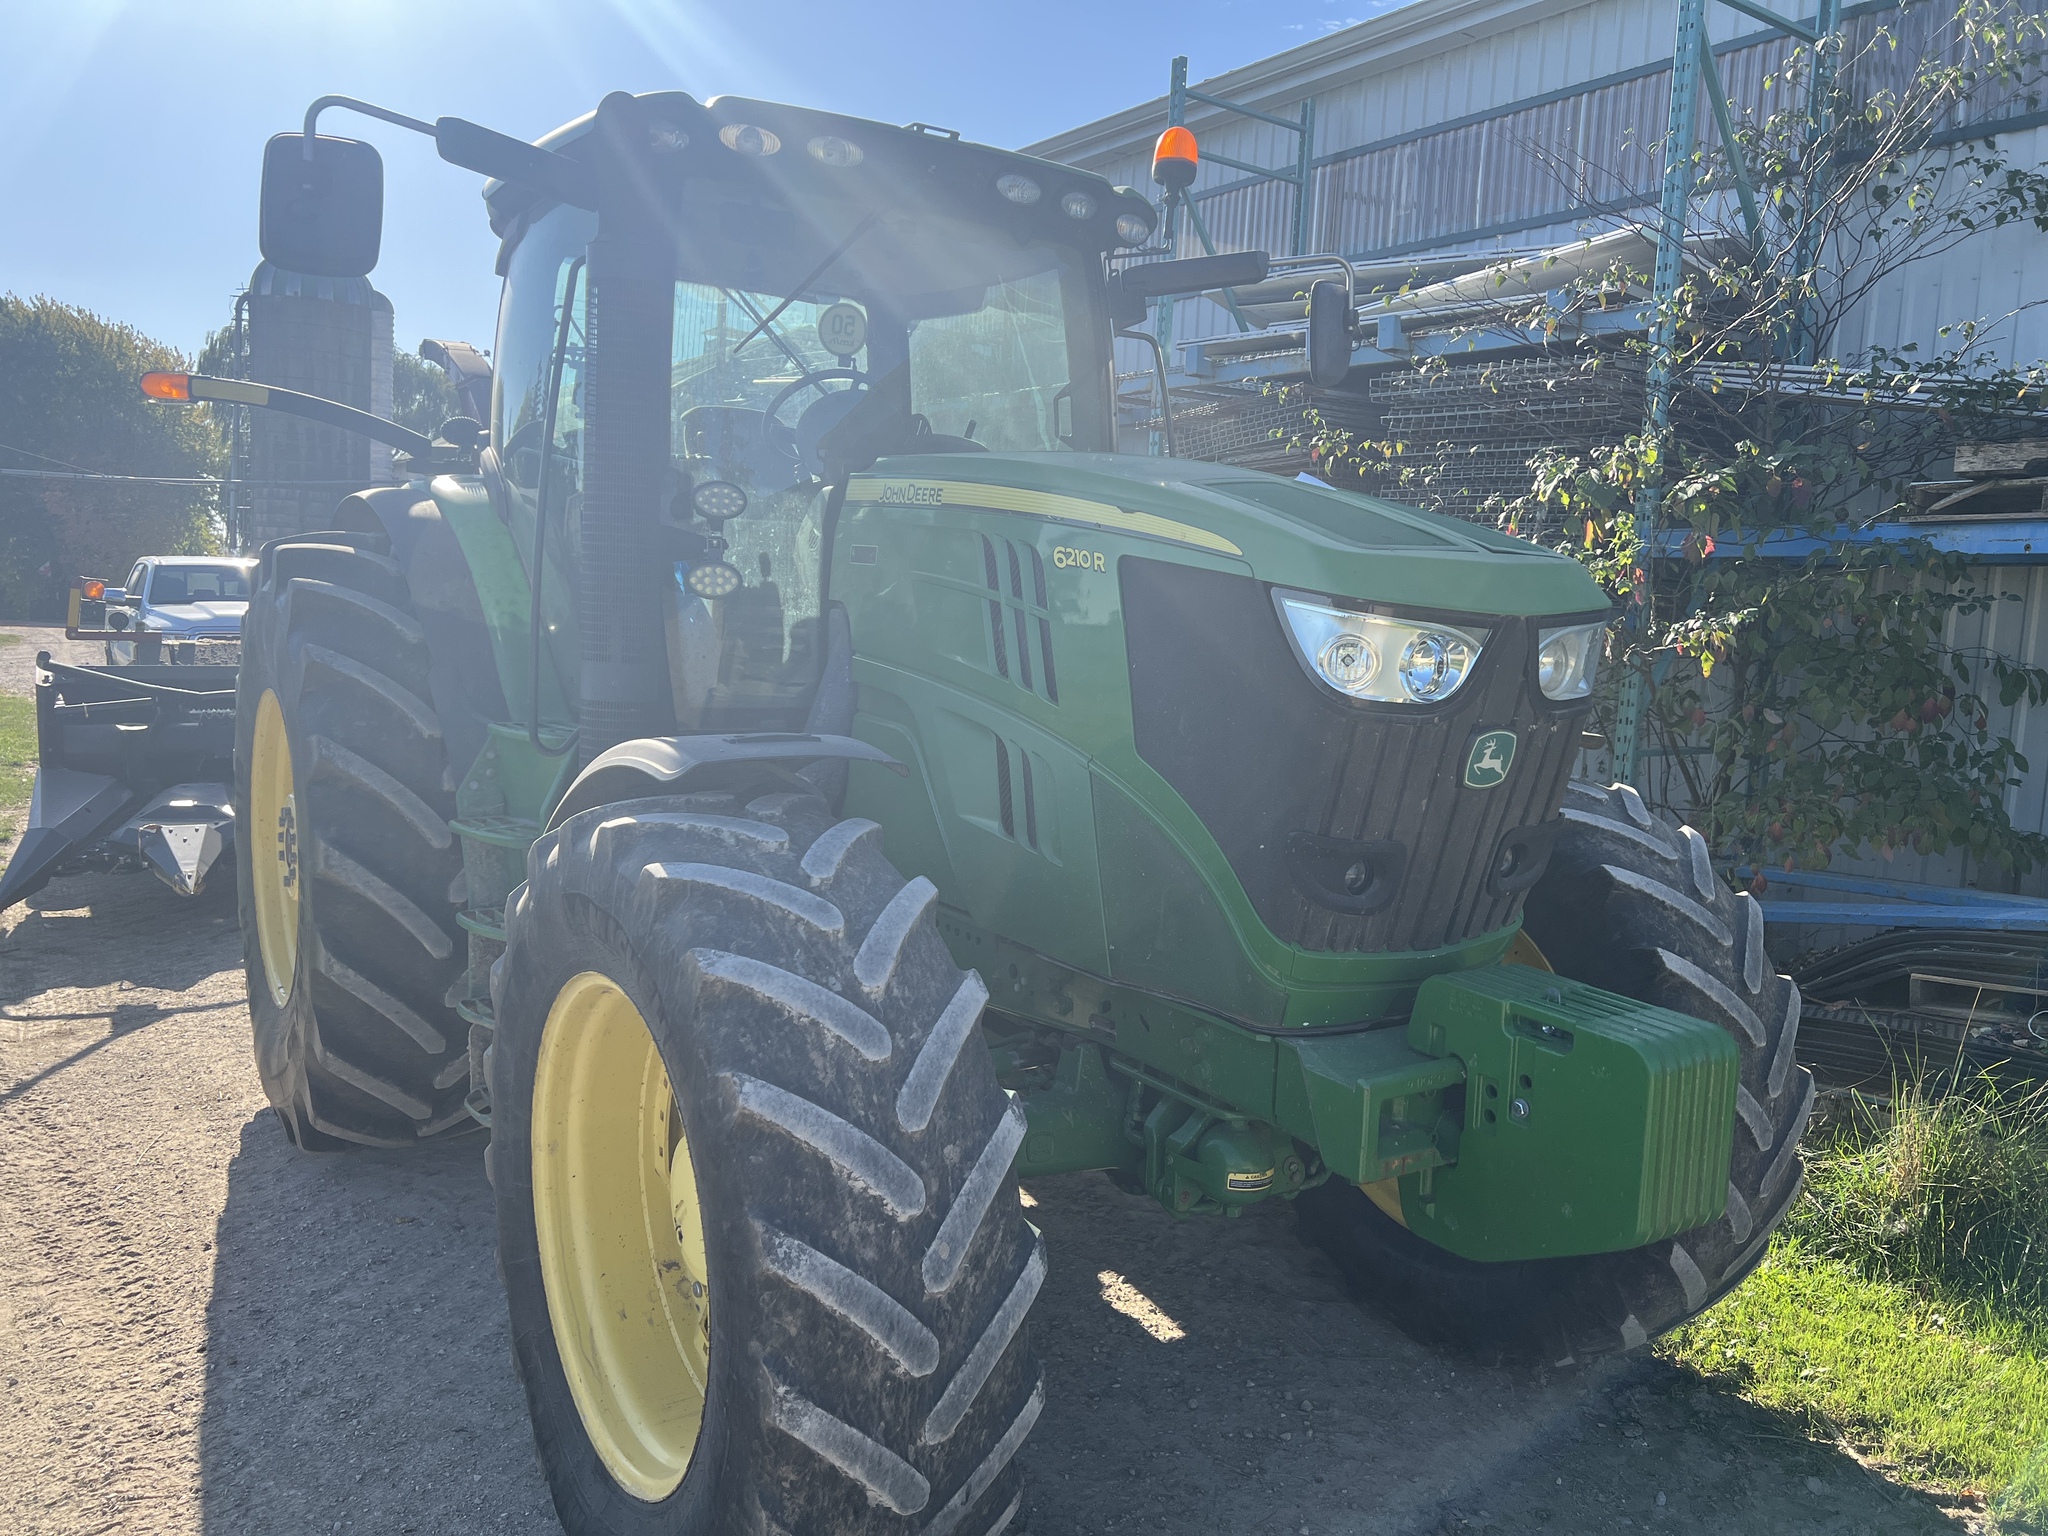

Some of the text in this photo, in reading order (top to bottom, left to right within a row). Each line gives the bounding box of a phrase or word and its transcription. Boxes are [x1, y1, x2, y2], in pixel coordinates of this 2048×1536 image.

[879, 483, 944, 503] JOHN DEERE
[1053, 545, 1106, 573] 6210 R
